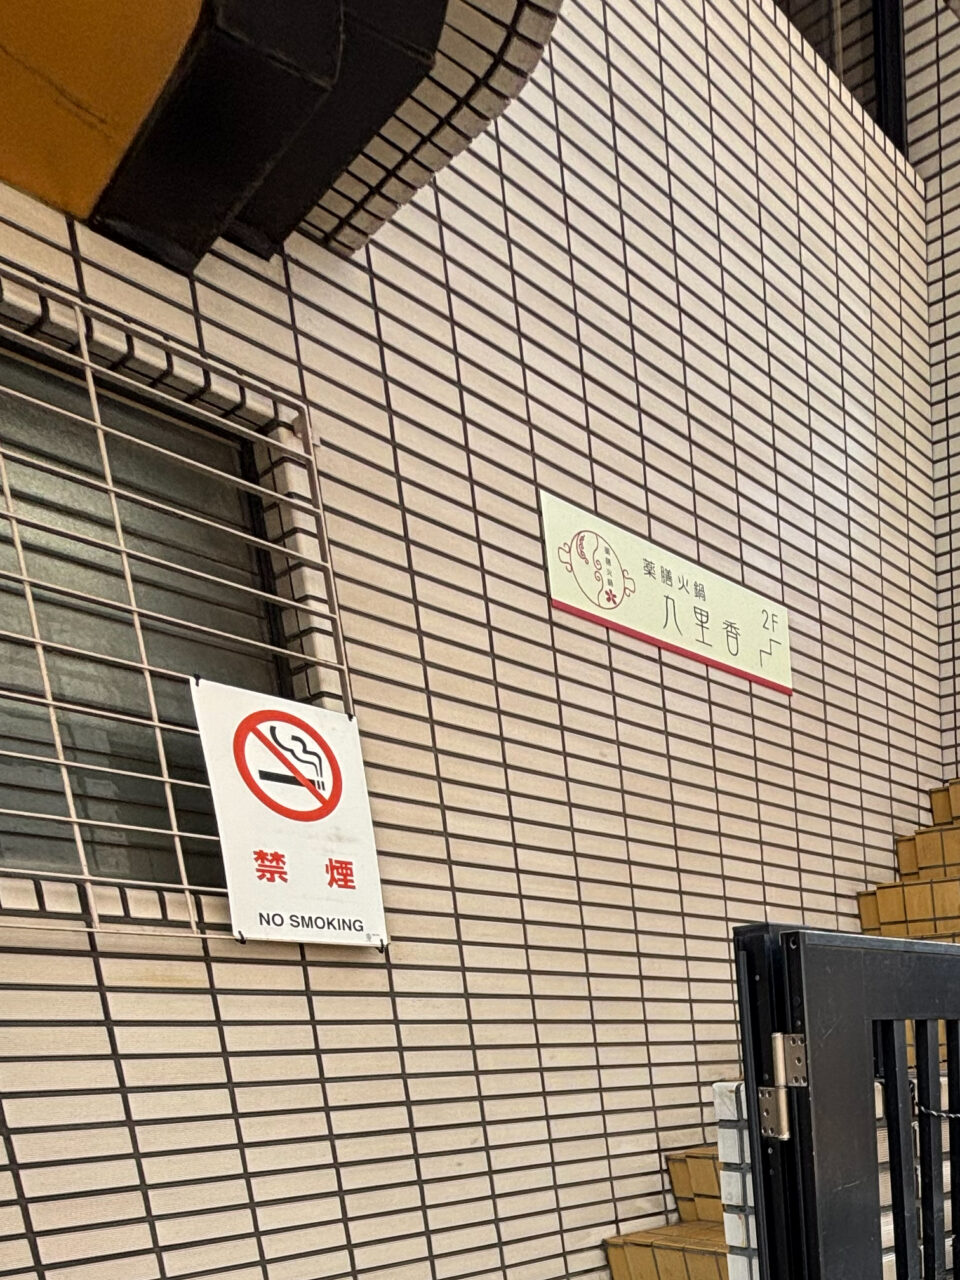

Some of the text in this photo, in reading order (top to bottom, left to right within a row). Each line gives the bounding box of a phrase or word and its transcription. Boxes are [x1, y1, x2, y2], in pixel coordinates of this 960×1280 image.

[643, 558, 706, 602] 薬膳火鍋
[761, 609, 778, 632] 2F
[253, 849, 356, 890] 禁煙
[258, 912, 364, 933] NO SMOKING
